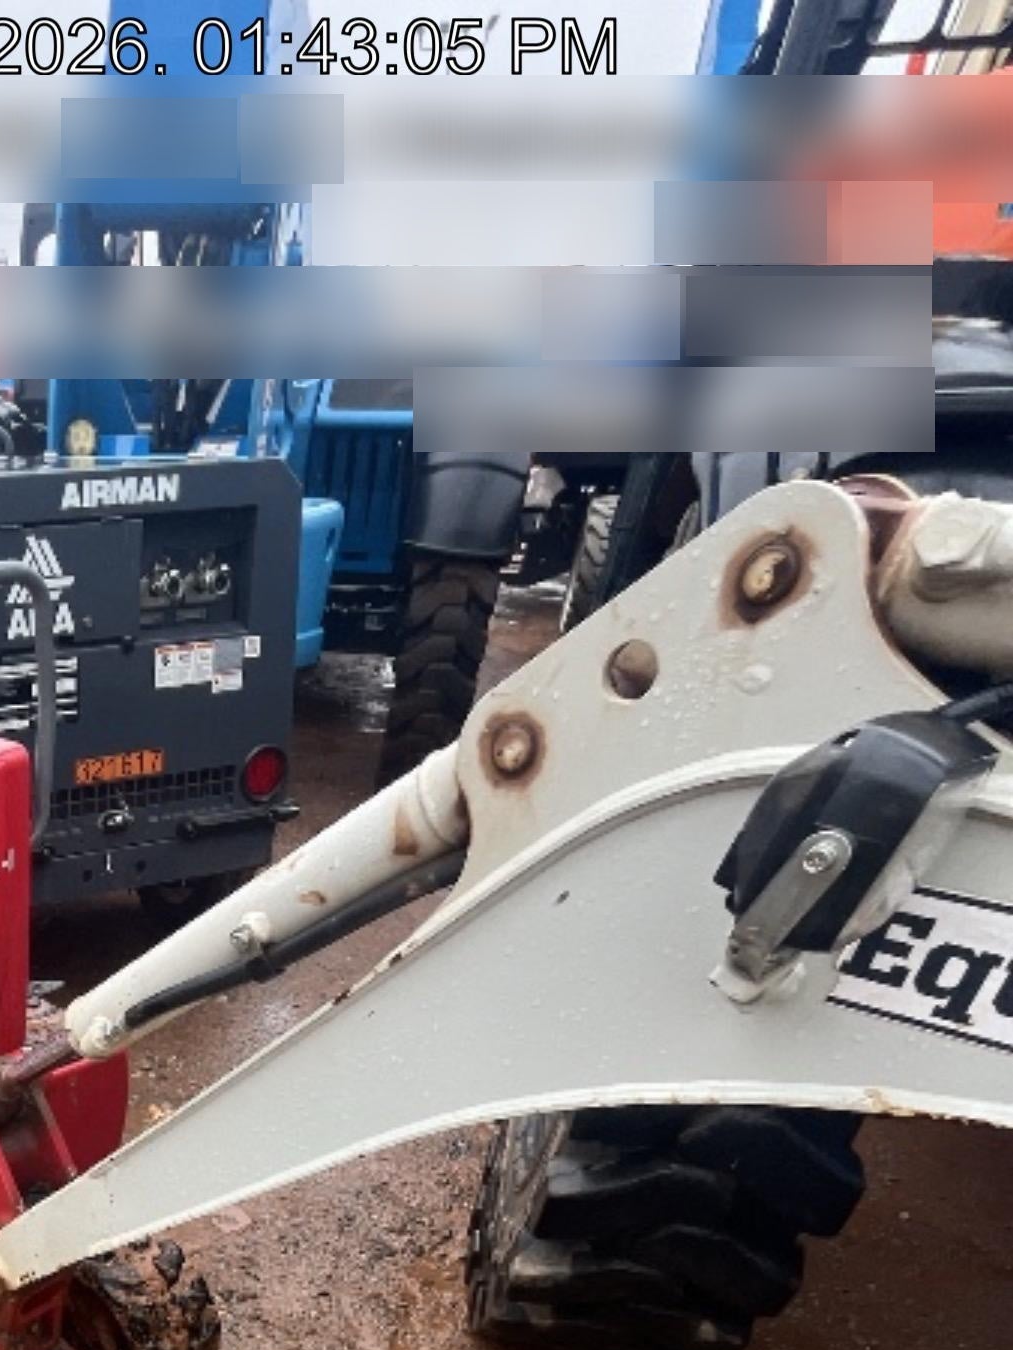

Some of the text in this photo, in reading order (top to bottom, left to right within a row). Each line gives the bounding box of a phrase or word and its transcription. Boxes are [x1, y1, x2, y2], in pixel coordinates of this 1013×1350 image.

[61, 473, 181, 510] AIRMAN
[7, 602, 75, 640] AA
[839, 911, 1013, 1026] Eq
